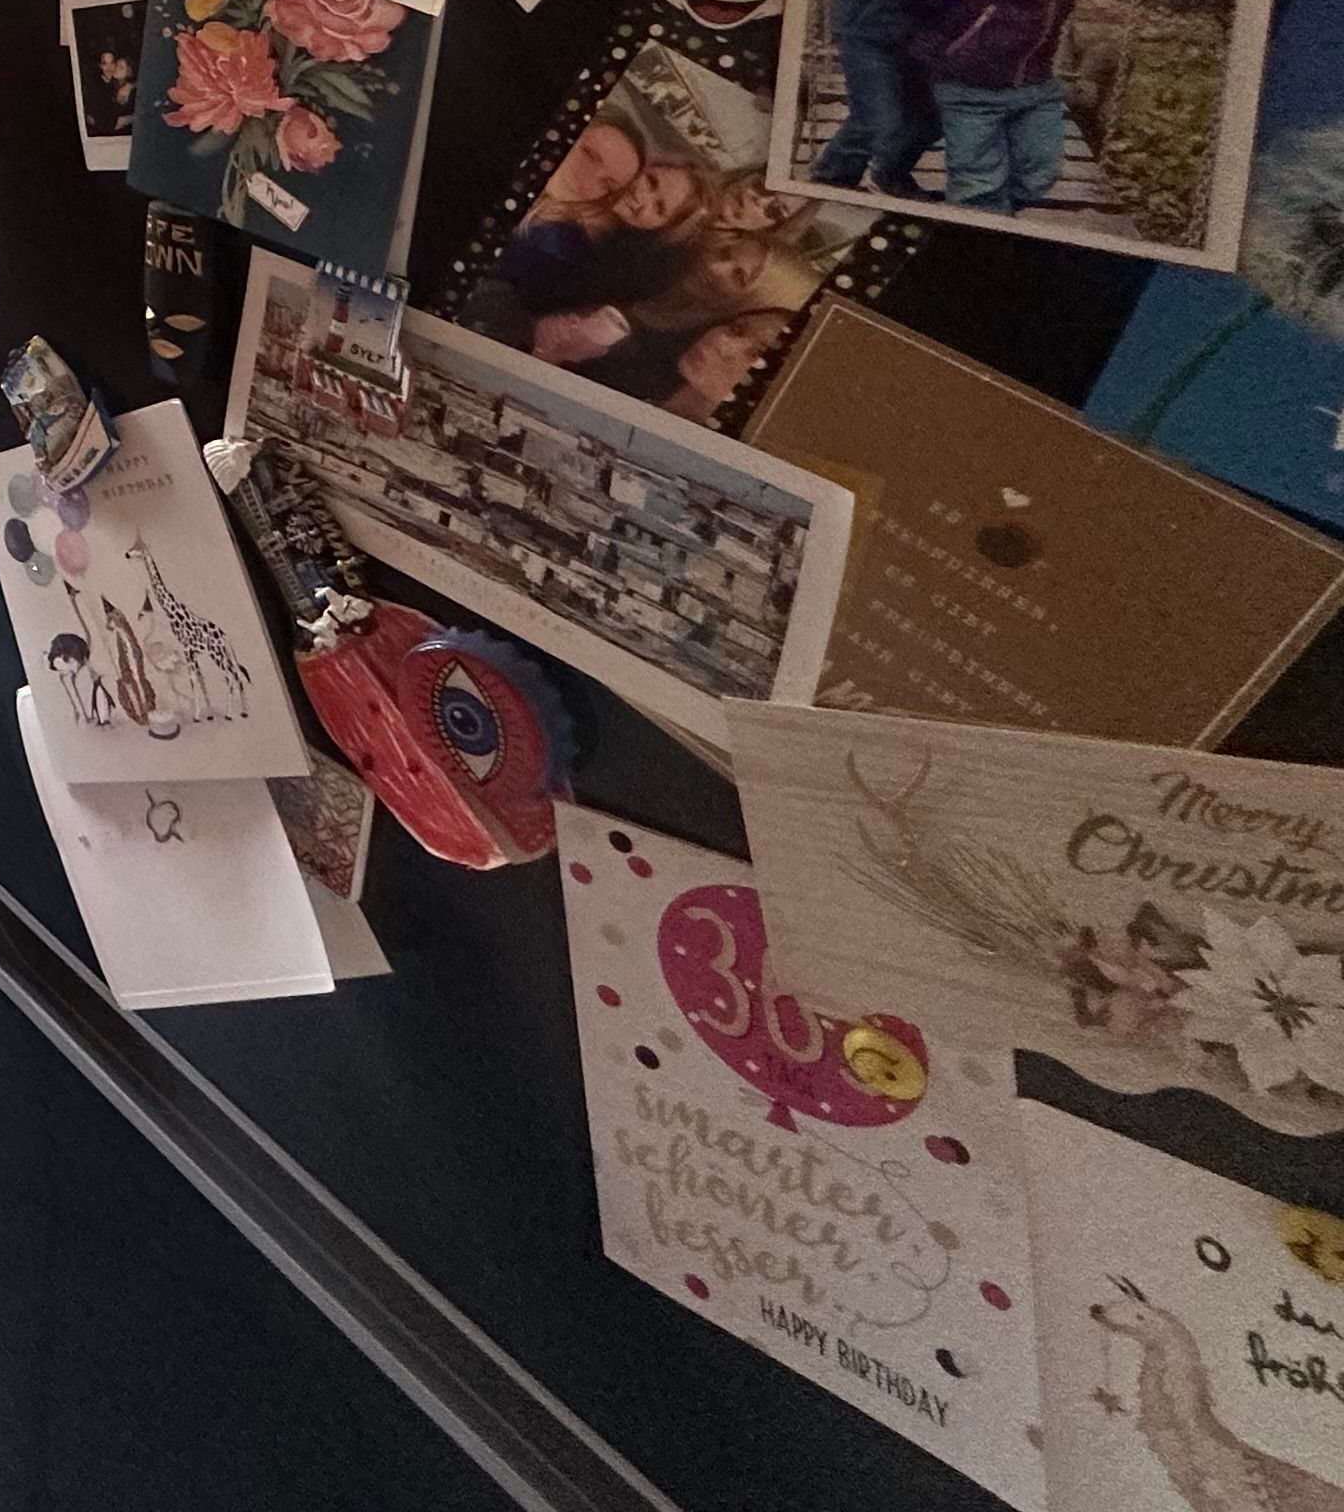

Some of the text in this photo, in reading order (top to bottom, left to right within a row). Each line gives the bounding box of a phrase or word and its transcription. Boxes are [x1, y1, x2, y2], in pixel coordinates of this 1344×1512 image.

[348, 343, 386, 365] SYLT
[100, 472, 177, 501] BIRTHDAY
[105, 453, 152, 475] HAPPY
[1149, 770, 1340, 858] Merry
[1065, 808, 1344, 915] Christm
[682, 905, 825, 1063] 30
[759, 1294, 950, 1428] HAPPY BIRTHDAY
